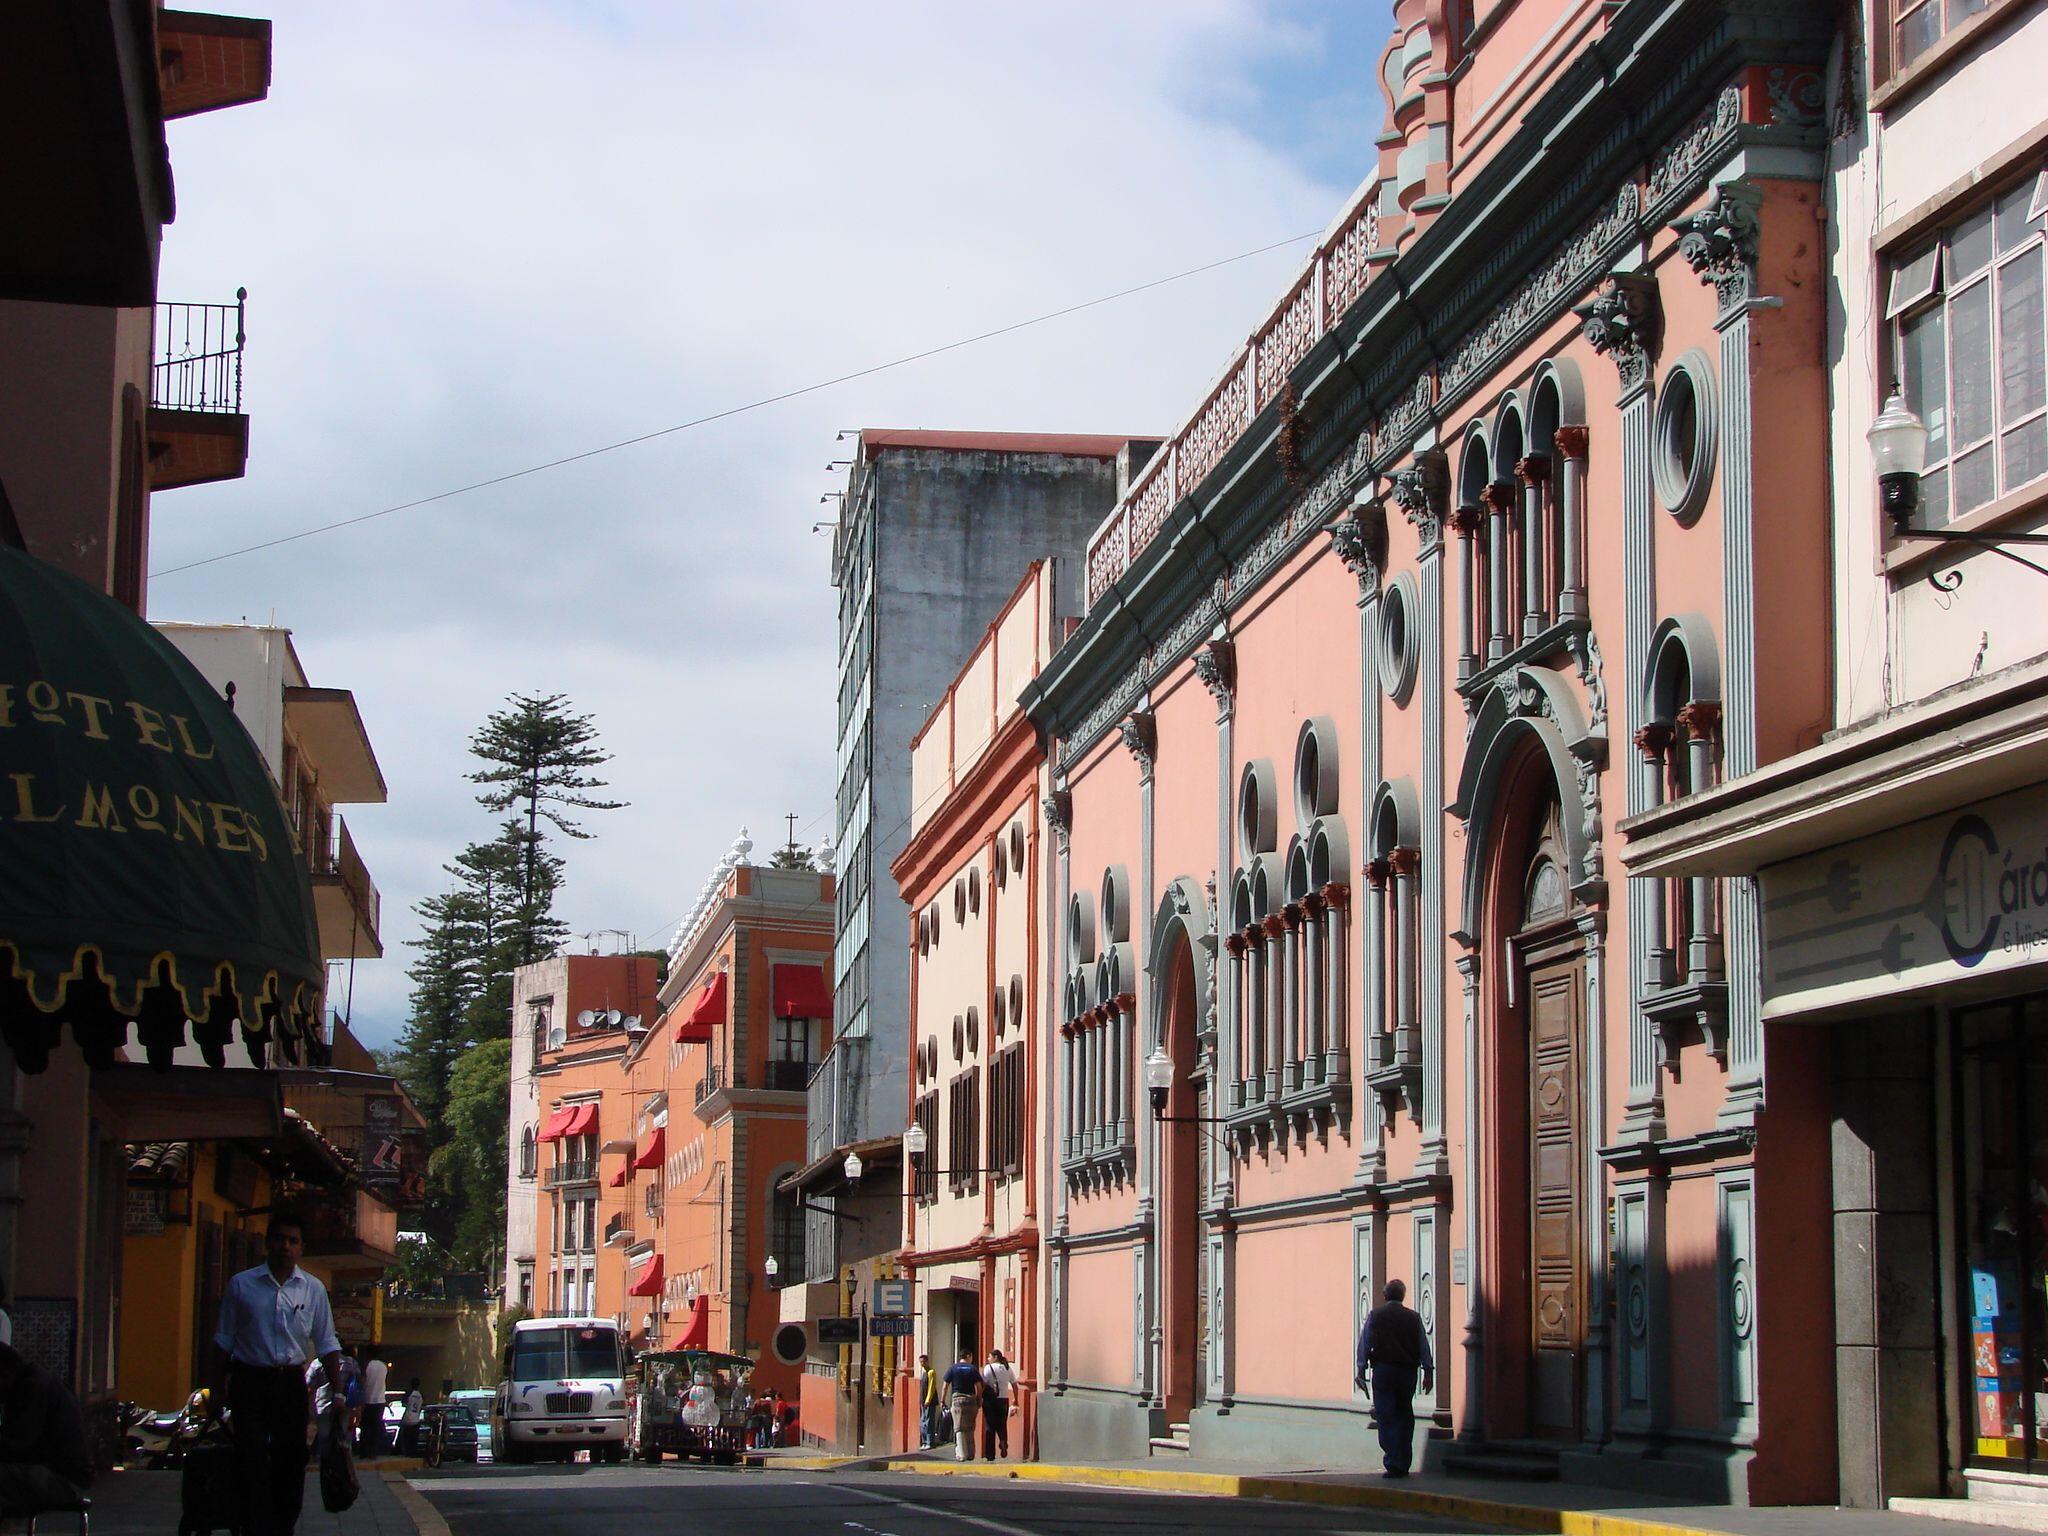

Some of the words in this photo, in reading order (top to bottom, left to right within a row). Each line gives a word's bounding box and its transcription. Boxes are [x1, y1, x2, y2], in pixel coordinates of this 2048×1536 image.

[0, 772, 267, 863] LMONES
[881, 1284, 904, 1312] E
[875, 1320, 909, 1333] PUBLICO
